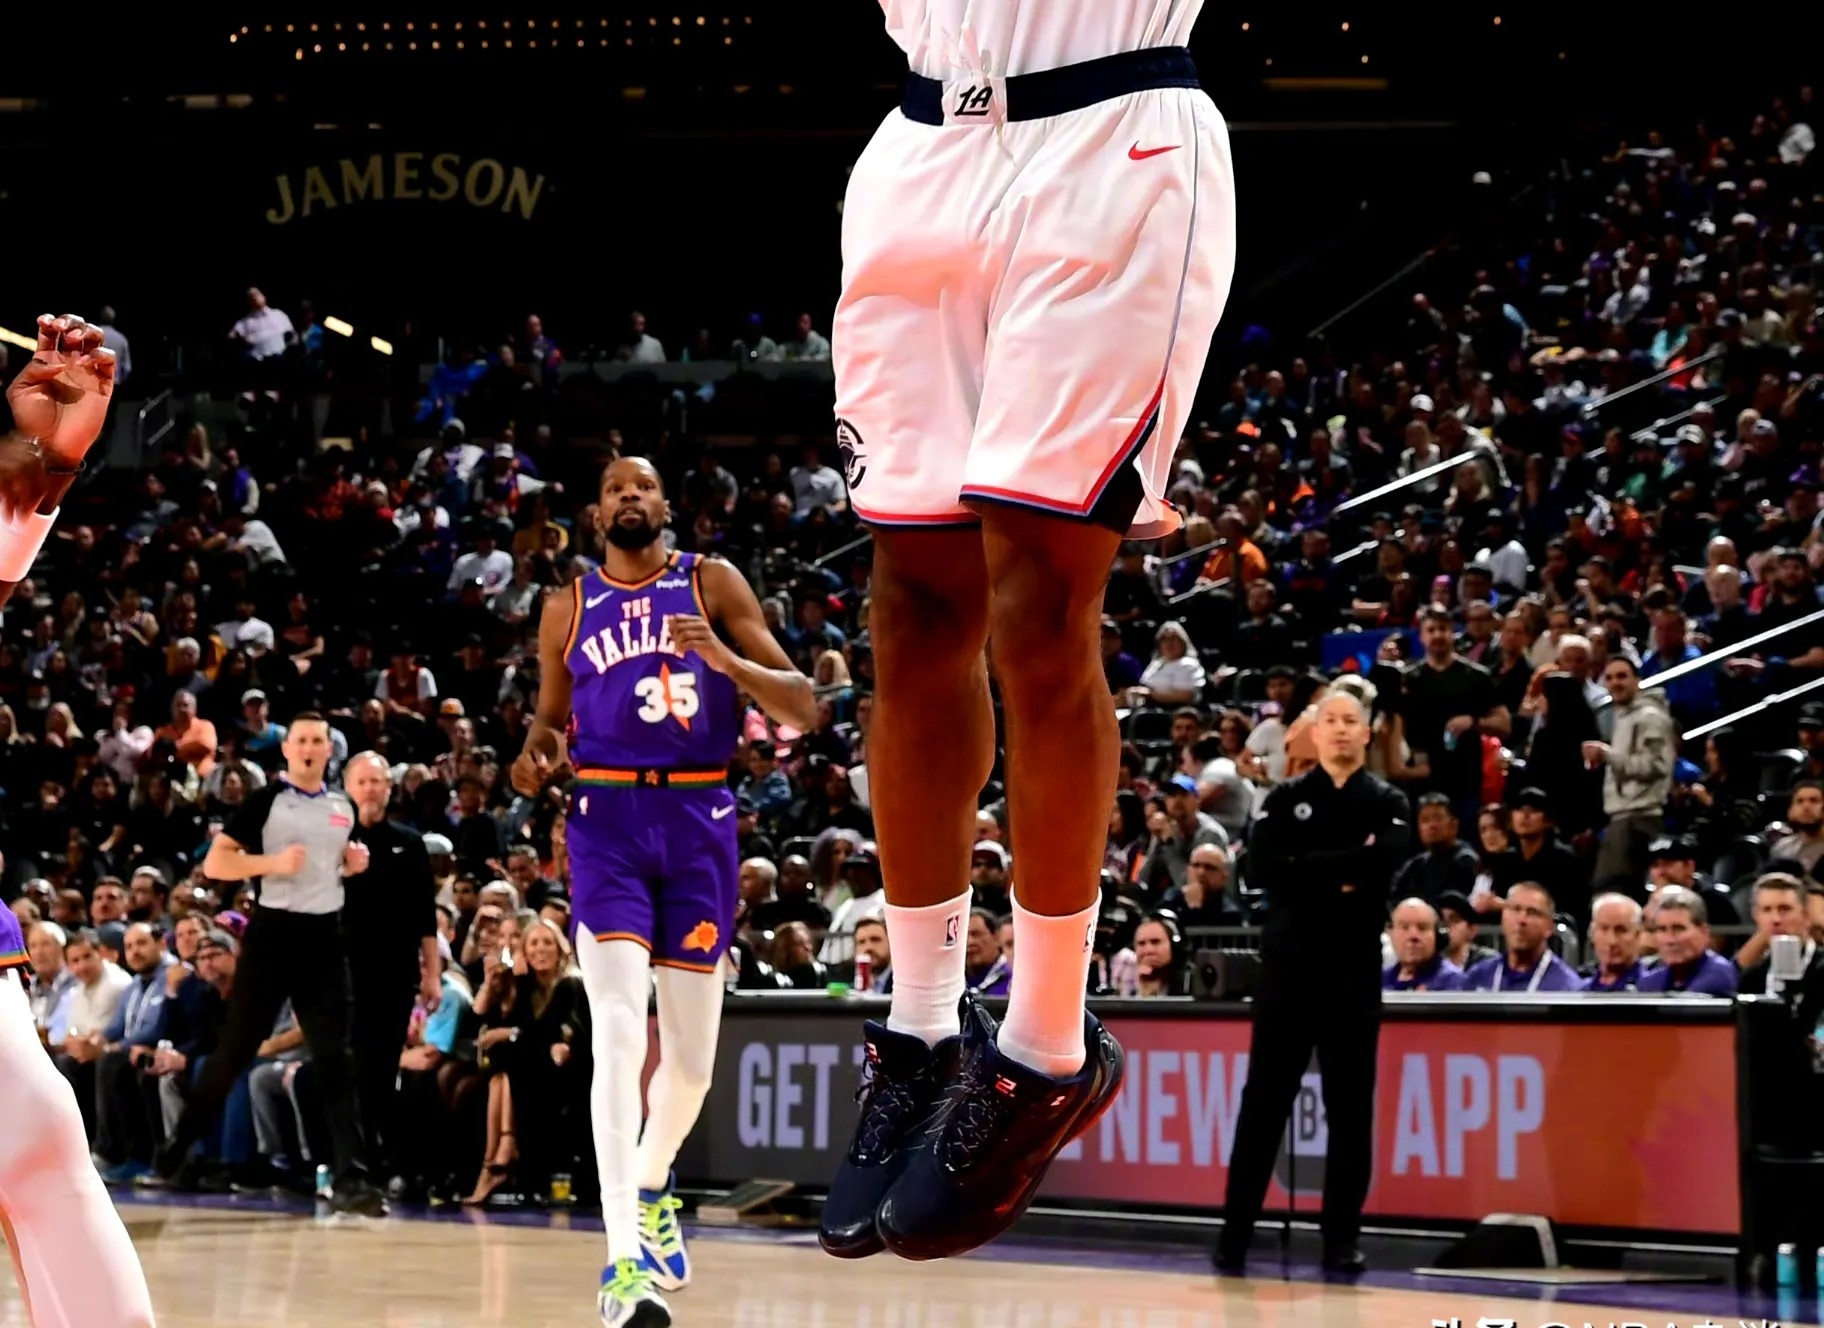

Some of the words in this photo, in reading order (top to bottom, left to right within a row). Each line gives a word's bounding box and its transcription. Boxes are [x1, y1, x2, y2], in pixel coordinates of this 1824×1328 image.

[266, 152, 546, 224] JAMESON
[621, 597, 652, 619] THE
[581, 615, 685, 675] VALLE
[634, 672, 699, 724] 35
[736, 1041, 840, 1150] GET
[1101, 1049, 1250, 1167] NEW
[1391, 1052, 1546, 1180] APP
